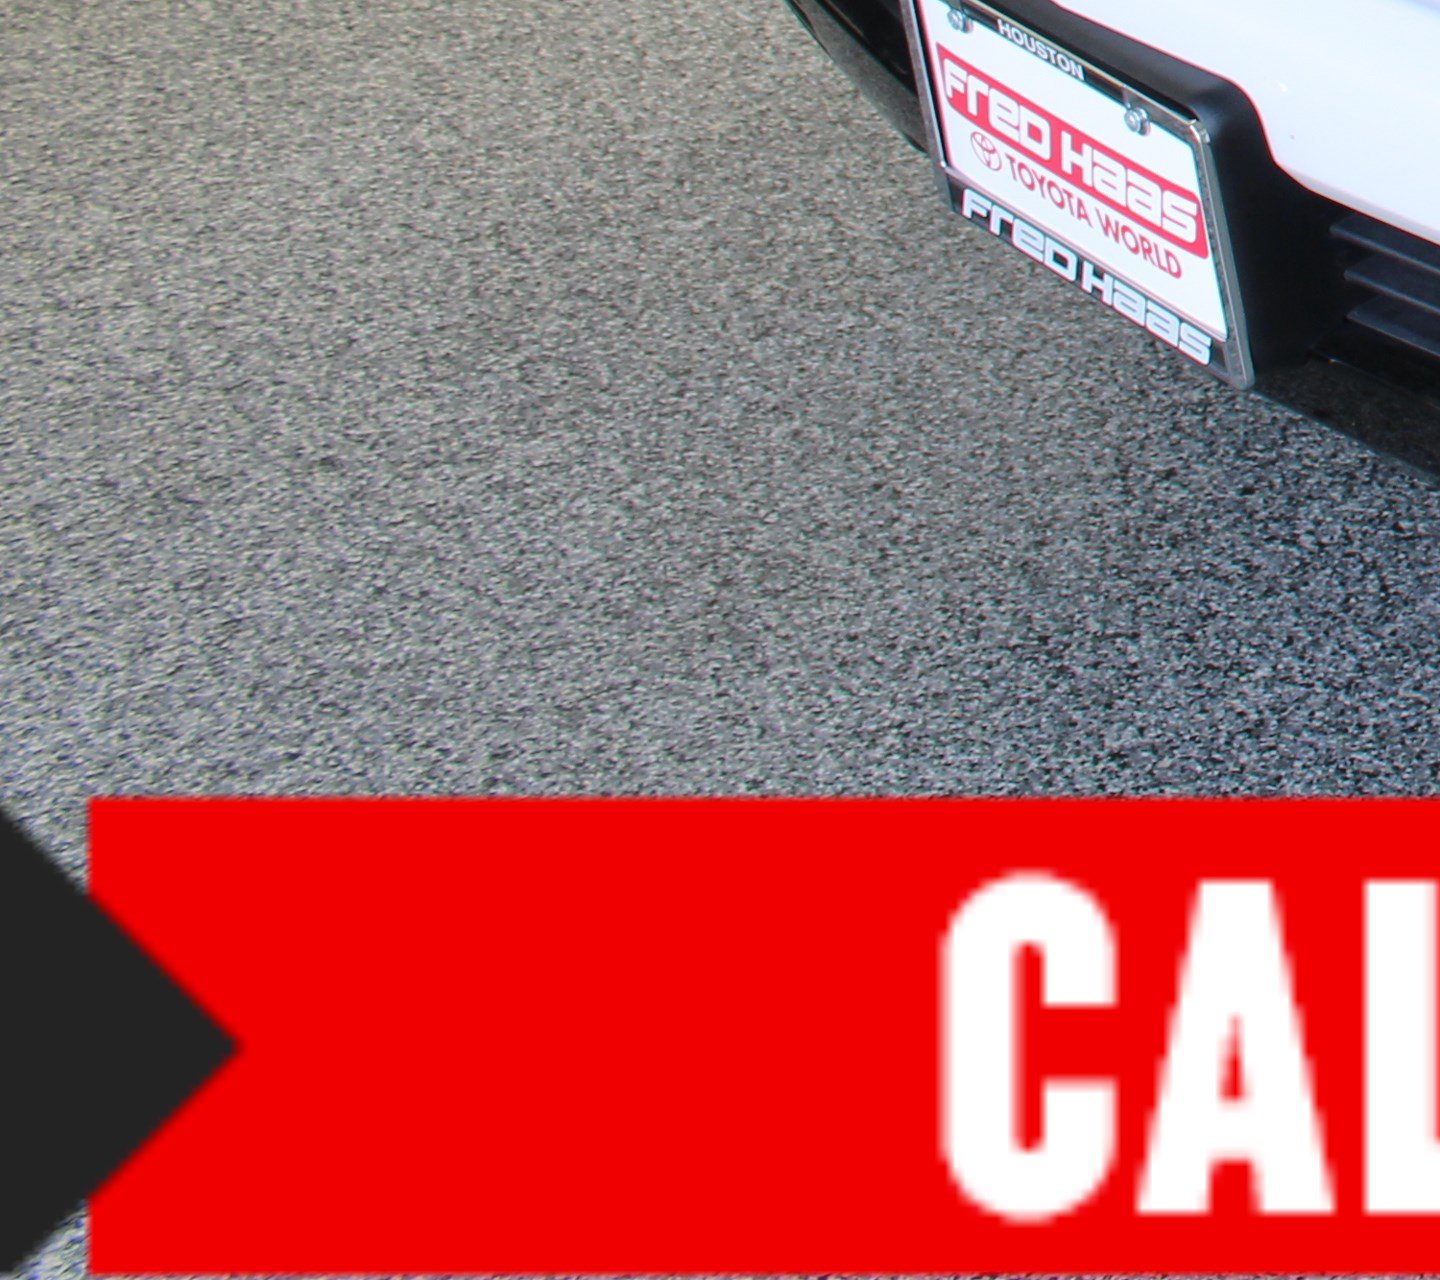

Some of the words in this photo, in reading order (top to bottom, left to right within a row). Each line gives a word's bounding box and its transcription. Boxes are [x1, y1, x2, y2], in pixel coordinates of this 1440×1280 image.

[998, 19, 1085, 81] HOUSTON
[1006, 154, 1095, 229] TOYOTA
[1096, 206, 1183, 280] WORLD
